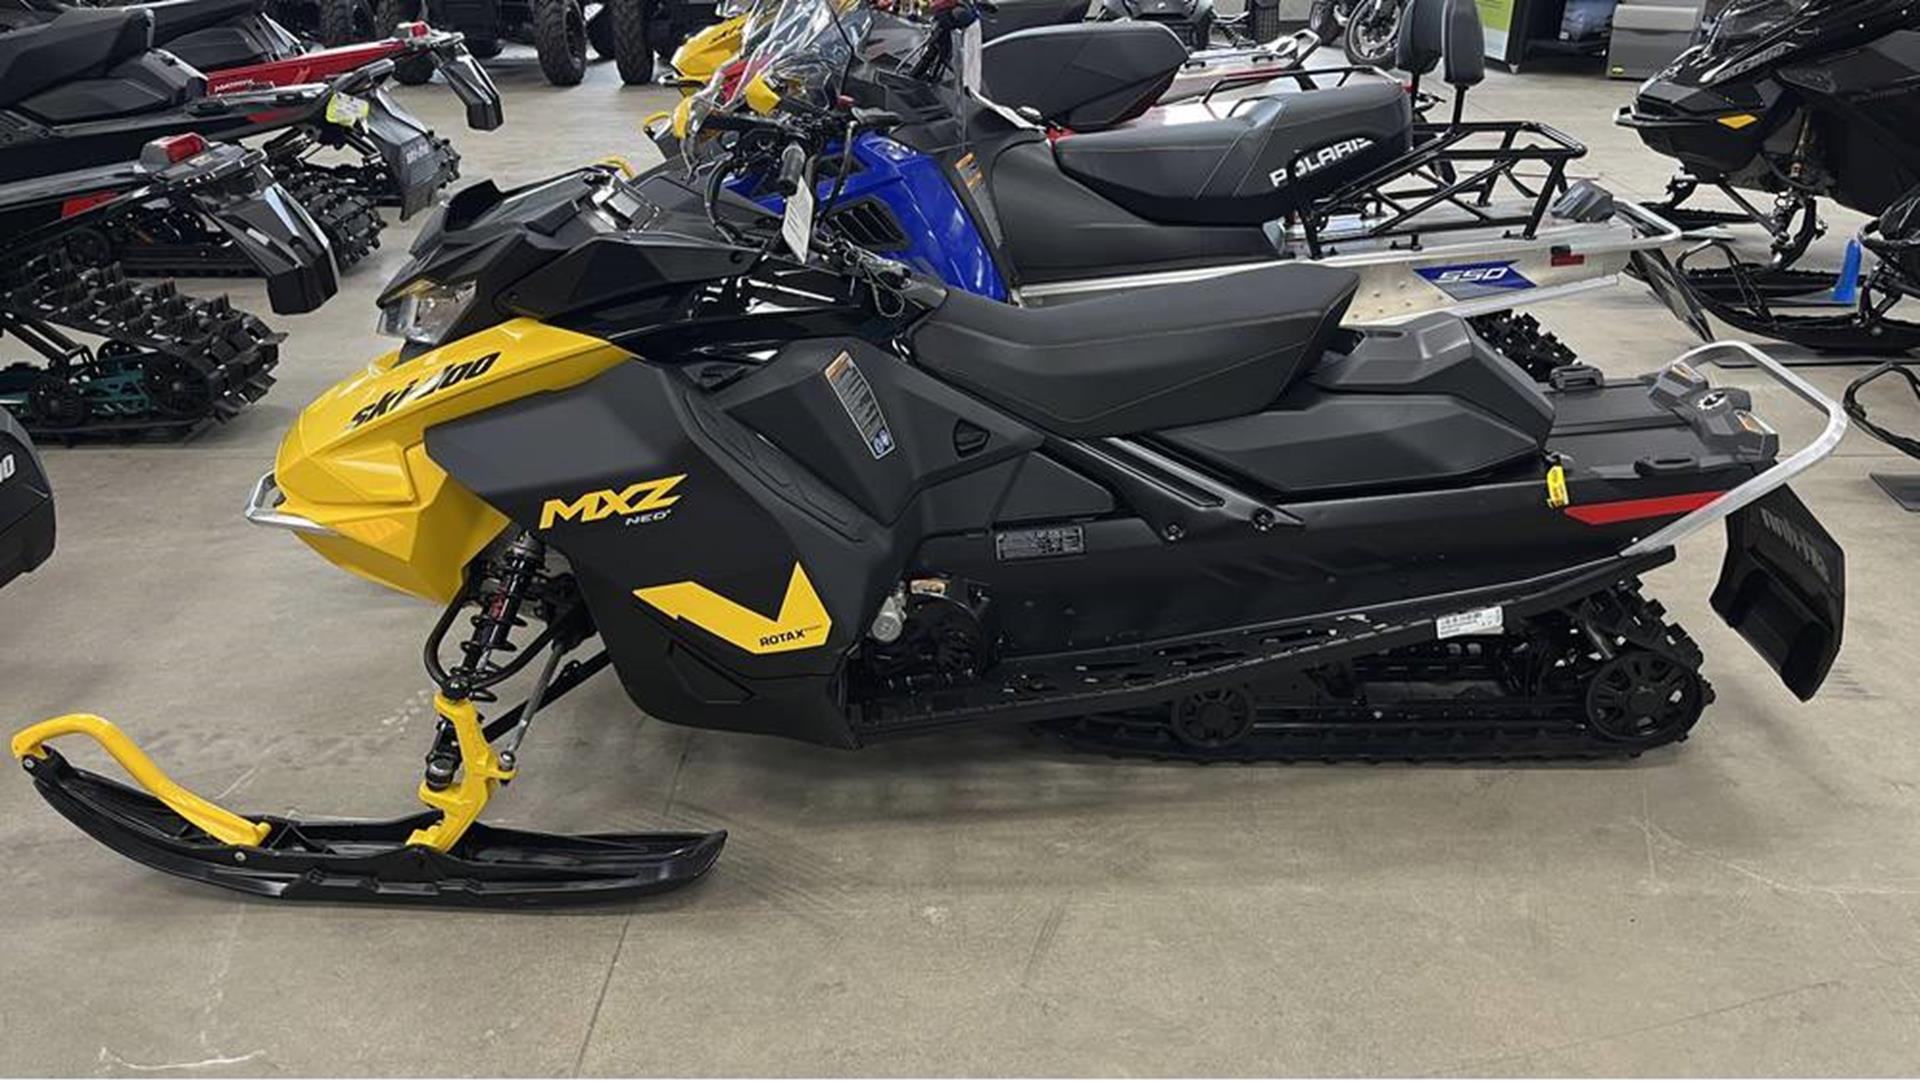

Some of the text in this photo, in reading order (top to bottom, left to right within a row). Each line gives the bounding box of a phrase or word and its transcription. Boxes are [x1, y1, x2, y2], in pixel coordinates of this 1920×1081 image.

[1268, 137, 1374, 187] POLARIS
[1435, 267, 1508, 284] 550
[539, 473, 688, 530] MXZ
[759, 629, 805, 647] ROTAX
